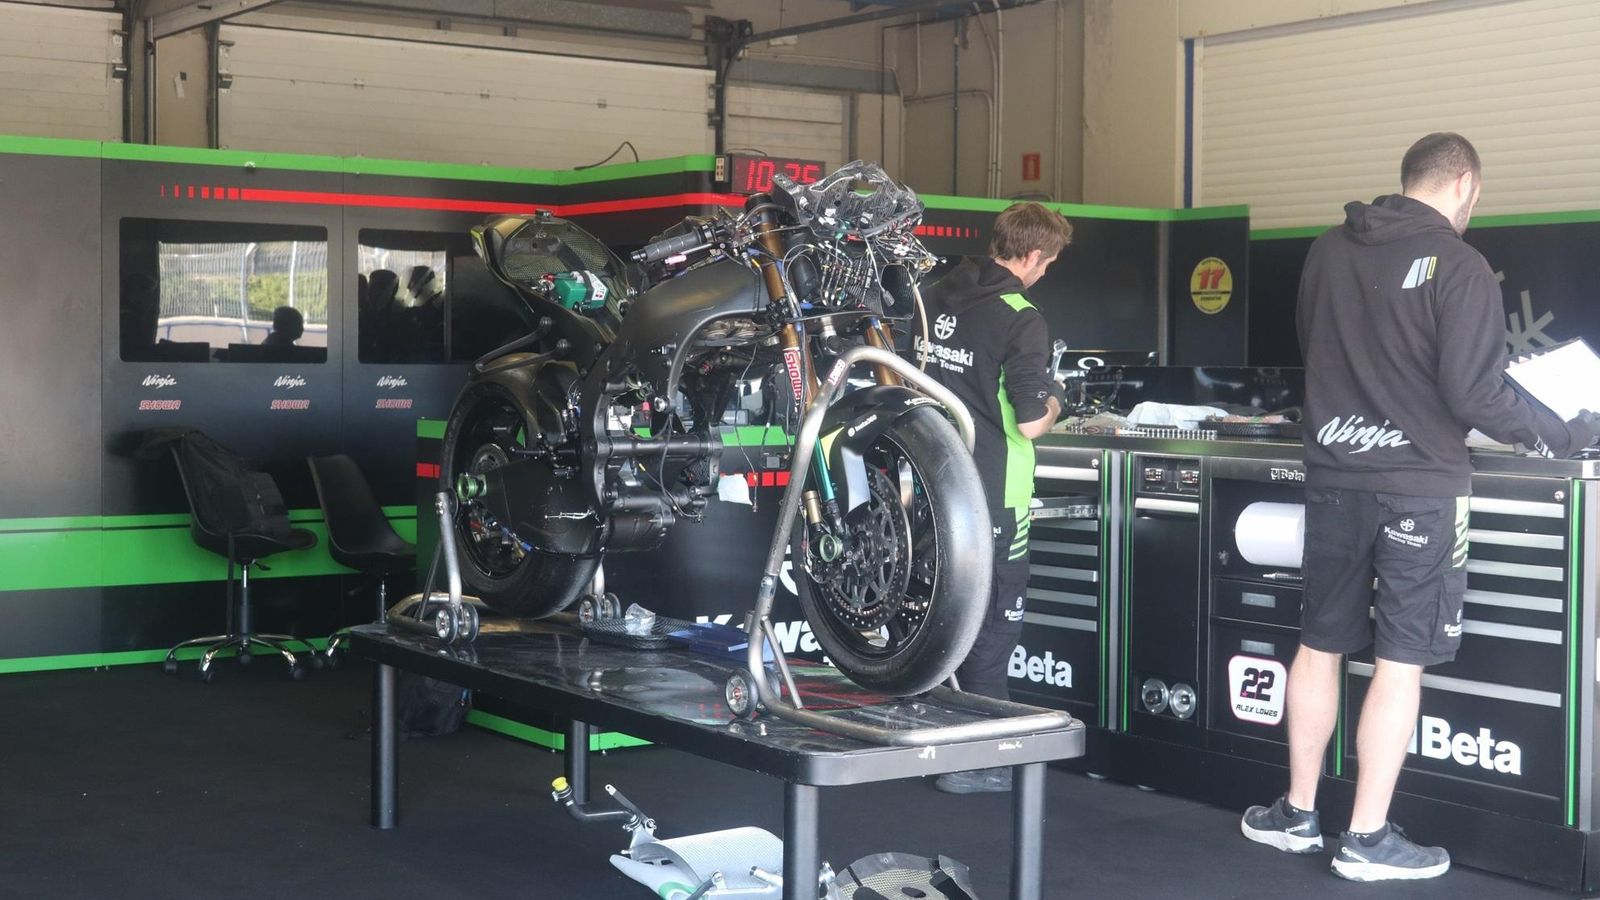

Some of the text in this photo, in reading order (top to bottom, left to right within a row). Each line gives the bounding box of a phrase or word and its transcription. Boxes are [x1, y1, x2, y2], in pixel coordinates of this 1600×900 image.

[1198, 266, 1226, 290] 17
[913, 335, 974, 367] Kawasaki
[939, 359, 964, 374] Team
[141, 374, 178, 390] Ninja
[273, 374, 307, 390] Ninja
[376, 375, 408, 390] Ninja
[138, 399, 182, 411] SHOWA
[270, 399, 311, 410] SHOWA
[375, 399, 413, 409] SHOWA
[1316, 414, 1412, 454] Ninja
[1384, 525, 1429, 545] Kawasaki
[1007, 644, 1073, 688] Beta
[1239, 667, 1276, 702] 22
[1235, 703, 1279, 718] ALEX LOWES
[1421, 715, 1522, 776] Beta
